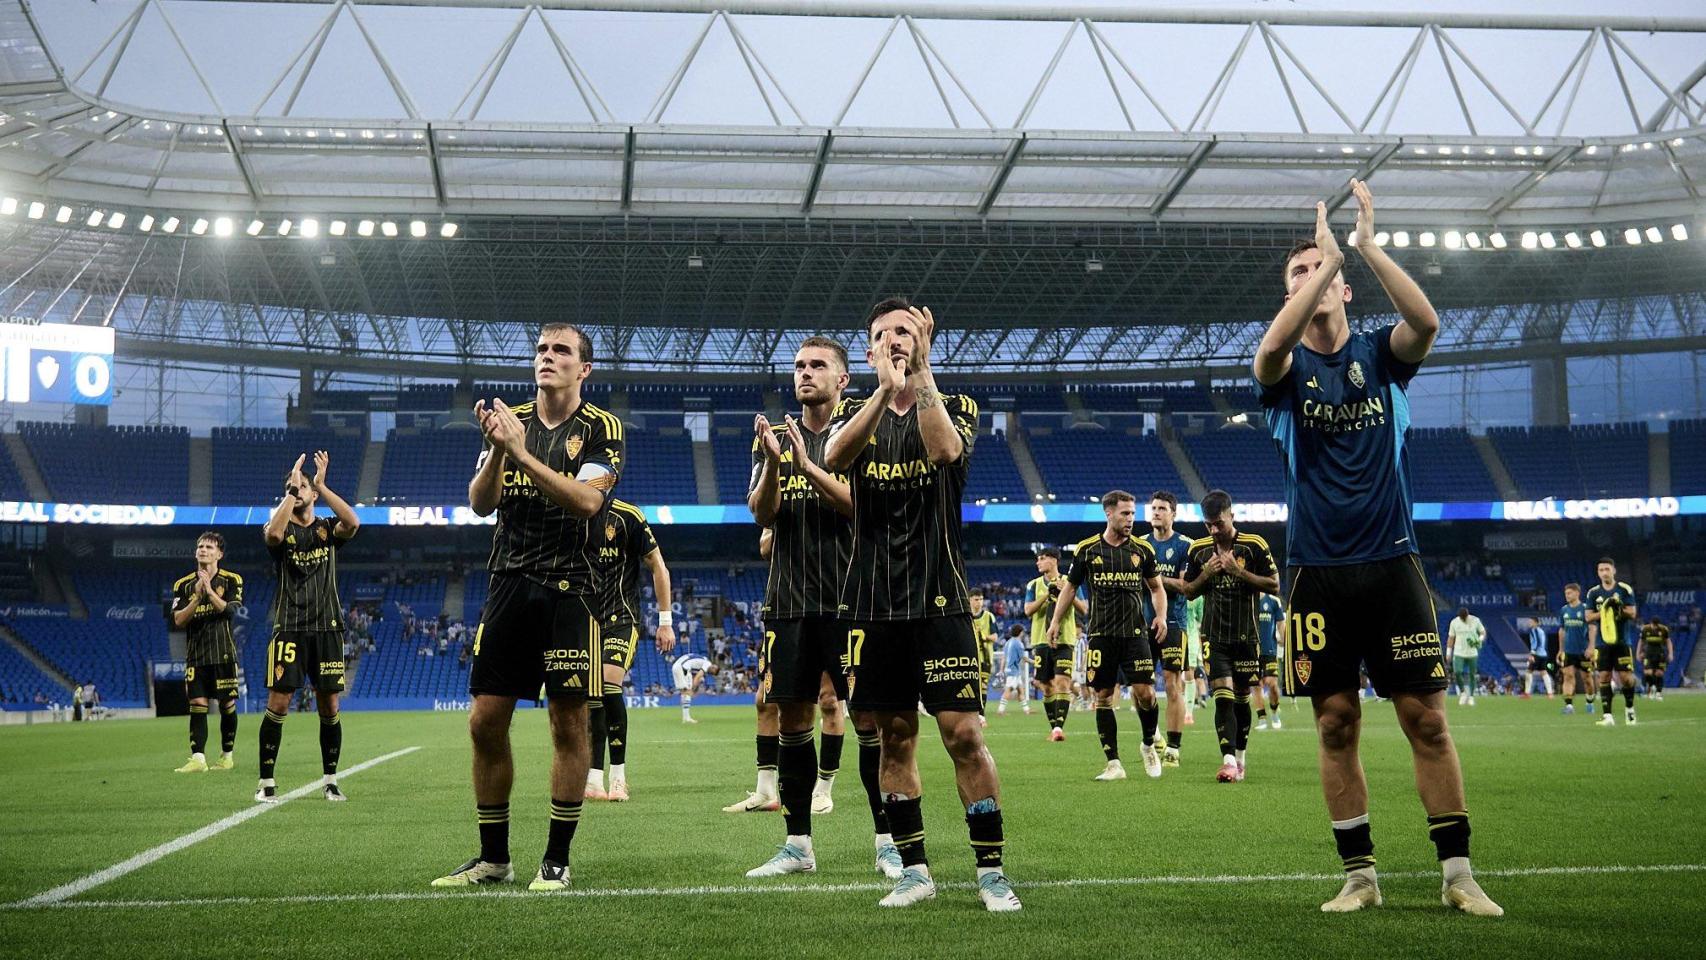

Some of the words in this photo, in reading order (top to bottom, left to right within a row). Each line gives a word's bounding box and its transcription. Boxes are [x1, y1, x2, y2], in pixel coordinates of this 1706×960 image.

[76, 355, 110, 398] 0
[1303, 397, 1384, 422] CARAVAN
[1303, 416, 1385, 432] FRGANCIAS
[862, 456, 937, 481] ARAVAN
[0, 500, 49, 521] EAL
[54, 502, 175, 524] SOCIEDAD
[389, 506, 449, 525] REAL
[1504, 499, 1561, 519] REAL
[1564, 497, 1679, 518] SOCIEDAD
[1093, 572, 1140, 581] CARAVAN
[17, 606, 50, 617] Halcón
[1292, 612, 1326, 651] 18
[276, 641, 296, 663] 15
[848, 629, 865, 667] 17
[1393, 646, 1442, 660] Zaratecn
[924, 657, 978, 670] SKODA
[1087, 649, 1101, 668] 19
[185, 666, 195, 681] 9
[925, 669, 978, 683] Zaratecno
